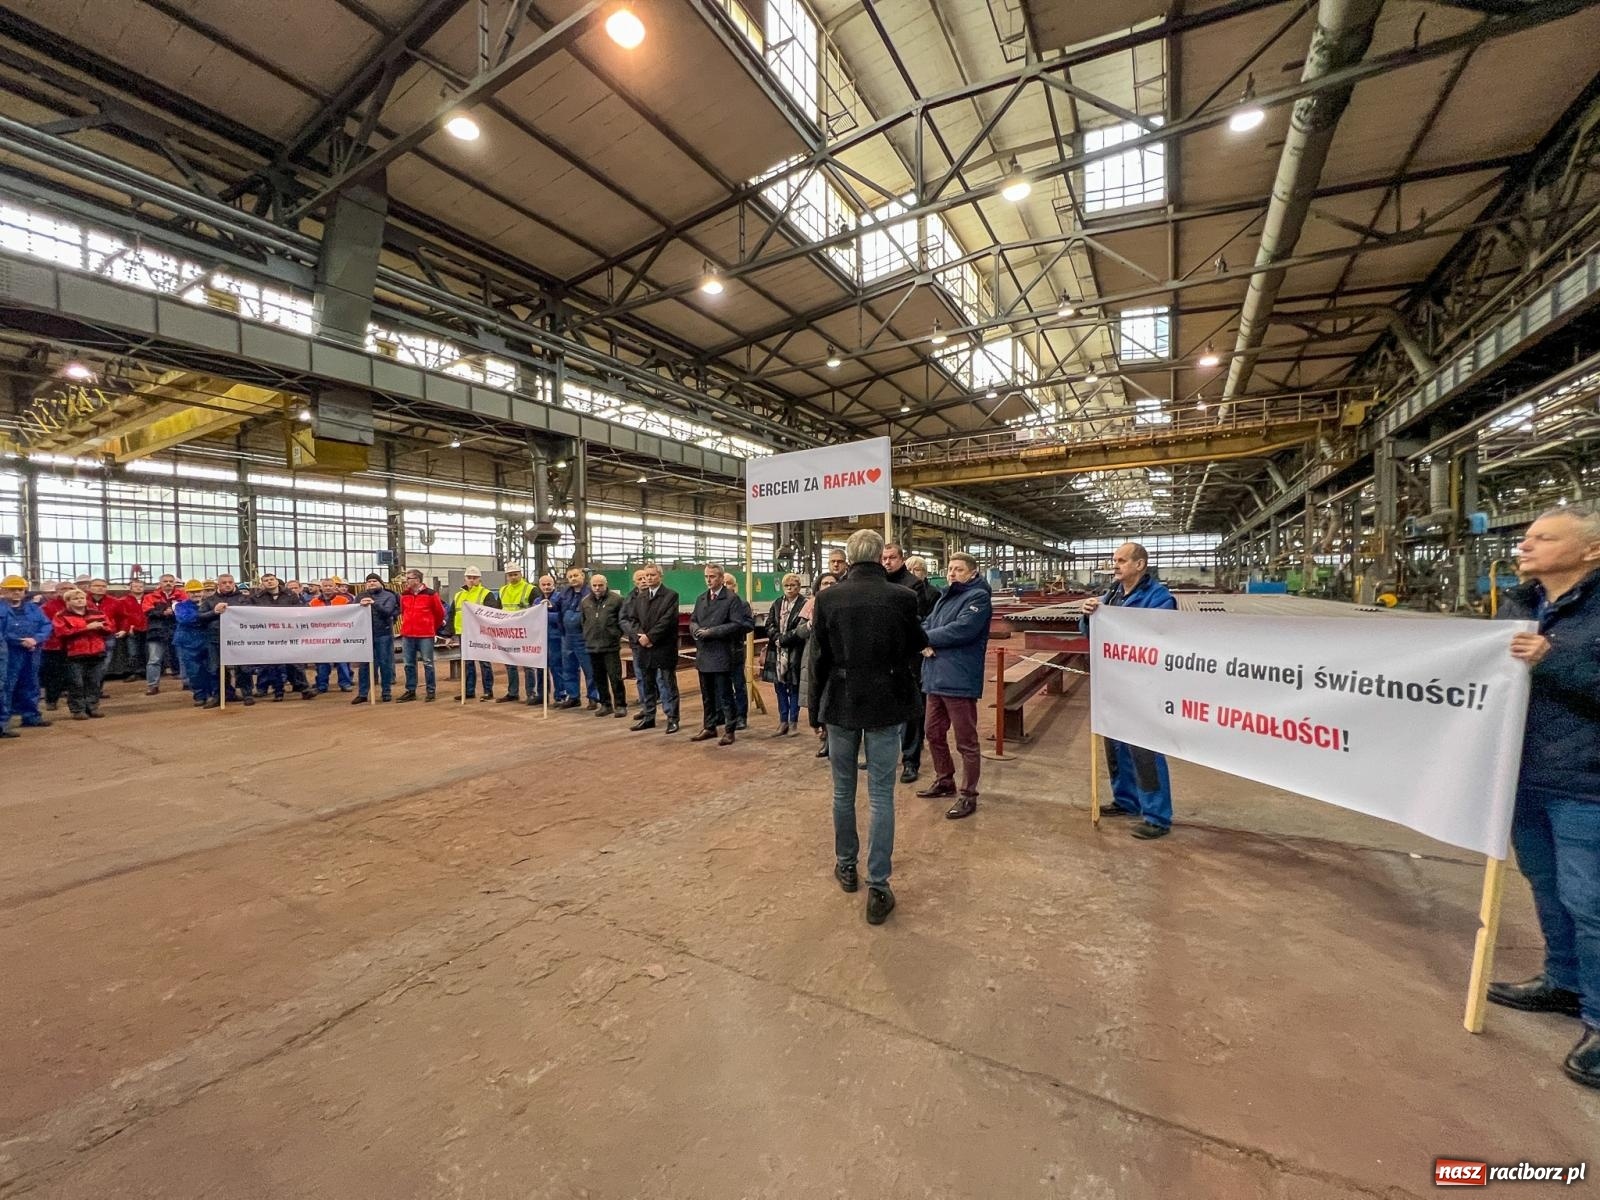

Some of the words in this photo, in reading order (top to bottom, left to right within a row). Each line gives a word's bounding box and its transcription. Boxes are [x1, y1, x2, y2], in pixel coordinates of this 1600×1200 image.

[752, 479, 799, 498] SERCEM
[804, 476, 819, 492] ZA
[1103, 642, 1159, 666] RAFAKO
[1164, 651, 1217, 674] godne
[1225, 657, 1304, 691] dawnej
[1314, 665, 1488, 711] świetności!
[1165, 698, 1175, 715] a
[1181, 699, 1209, 723] NIE
[1217, 706, 1350, 753] UPADŁOŚCI!
